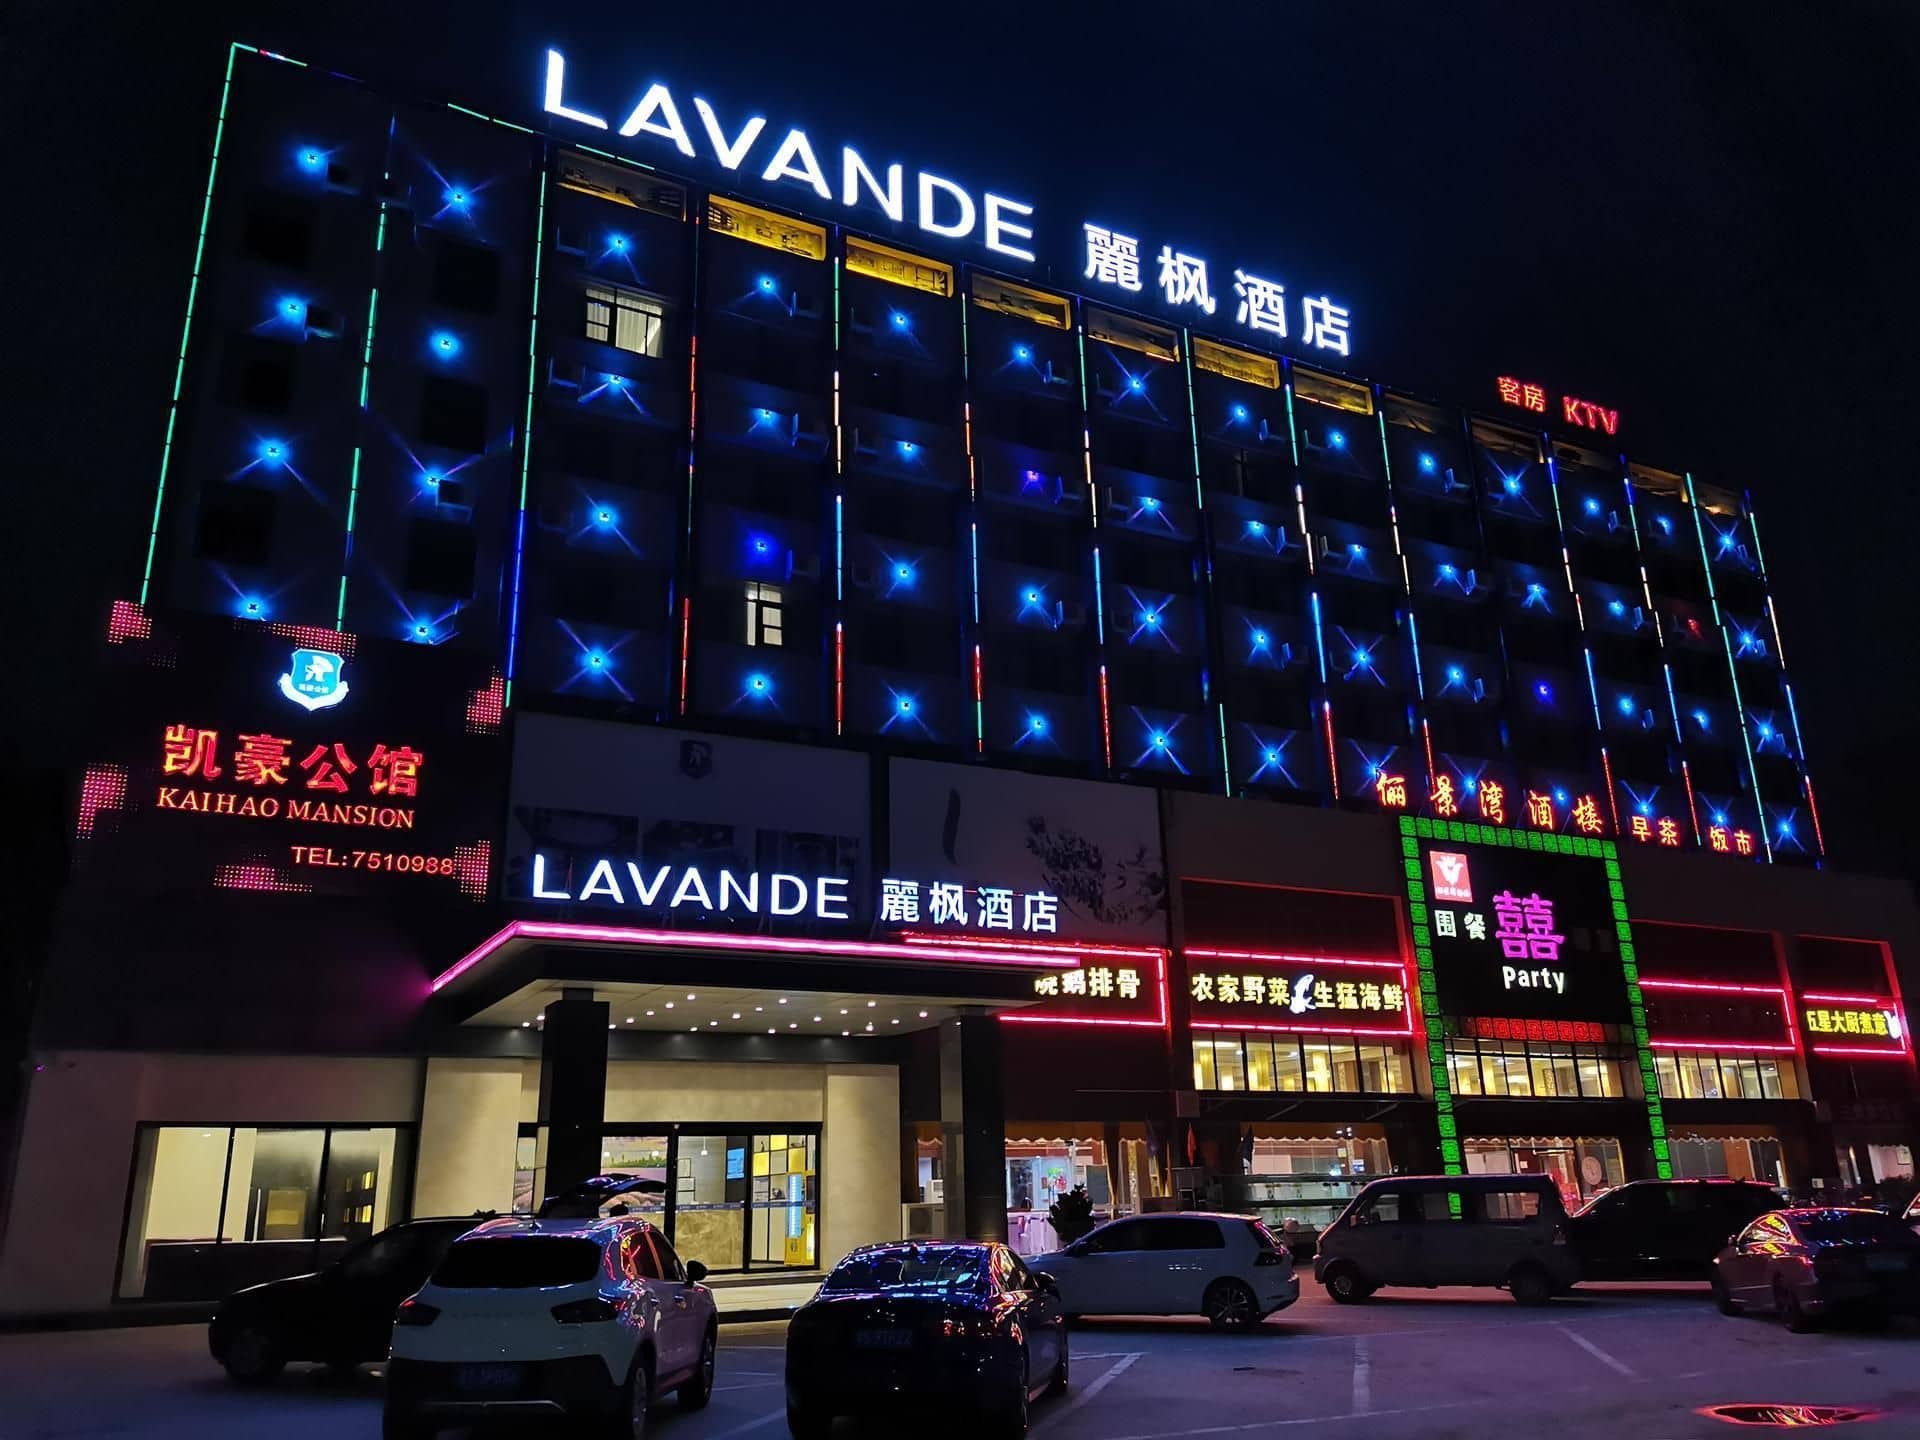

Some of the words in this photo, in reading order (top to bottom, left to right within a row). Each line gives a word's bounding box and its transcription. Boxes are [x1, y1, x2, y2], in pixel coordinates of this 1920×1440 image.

[543, 49, 1036, 263] LAVANDE
[1083, 222, 1351, 357] 麗枫酒店
[1497, 376, 1546, 412] 客房
[1562, 396, 1619, 435] KTV
[163, 724, 424, 797] 凯豪公馆
[156, 787, 279, 817] KAIHAO
[287, 799, 415, 829] MANSION
[1631, 815, 1679, 846] 早茶
[291, 846, 454, 875] TEL:7510988
[532, 854, 849, 919] LAVANDE
[880, 878, 1059, 933] 麗枫酒店
[1434, 909, 1486, 941] 围餐
[1191, 974, 1291, 1004] 农家野菜
[1315, 981, 1404, 1012] 生猛海鲜
[1502, 965, 1565, 994] Party
